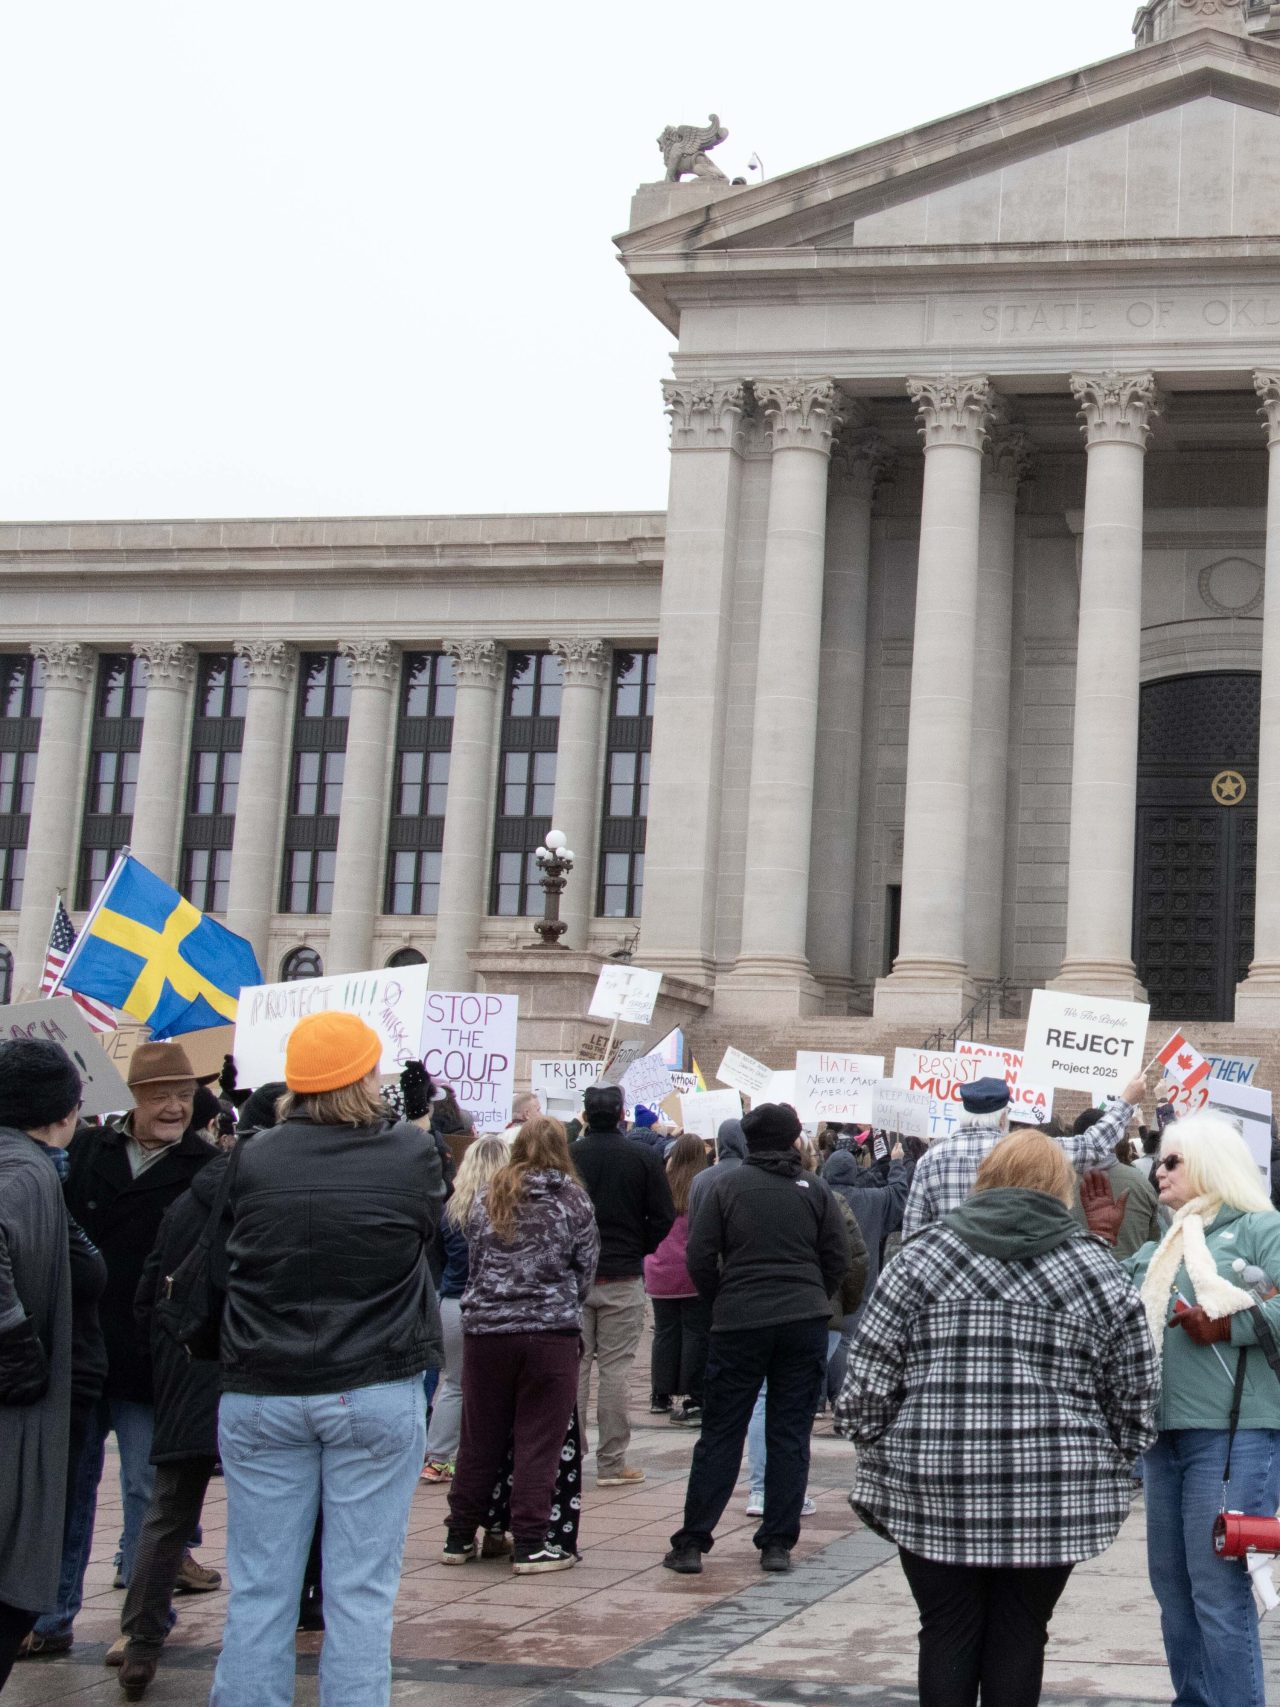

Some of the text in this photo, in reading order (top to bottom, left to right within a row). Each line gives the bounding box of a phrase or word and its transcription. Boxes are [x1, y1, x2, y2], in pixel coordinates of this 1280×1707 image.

[980, 303, 1097, 333] STATE
[1126, 301, 1175, 329] OF
[251, 984, 334, 1026] PROTECT
[426, 993, 503, 1026] STOP
[1063, 1007, 1128, 1028] We The People
[441, 1028, 484, 1049] THE
[1046, 1028, 1134, 1057] REJECT
[423, 1048, 508, 1082] COUP
[820, 1054, 859, 1072] HATE
[1051, 1060, 1118, 1078] Project 2025
[565, 1078, 577, 1089] IS
[806, 1074, 879, 1087] NEVER MADE
[909, 1075, 966, 1102] MUC
[809, 1087, 859, 1098] AMERICA
[815, 1100, 858, 1117] GREAT
